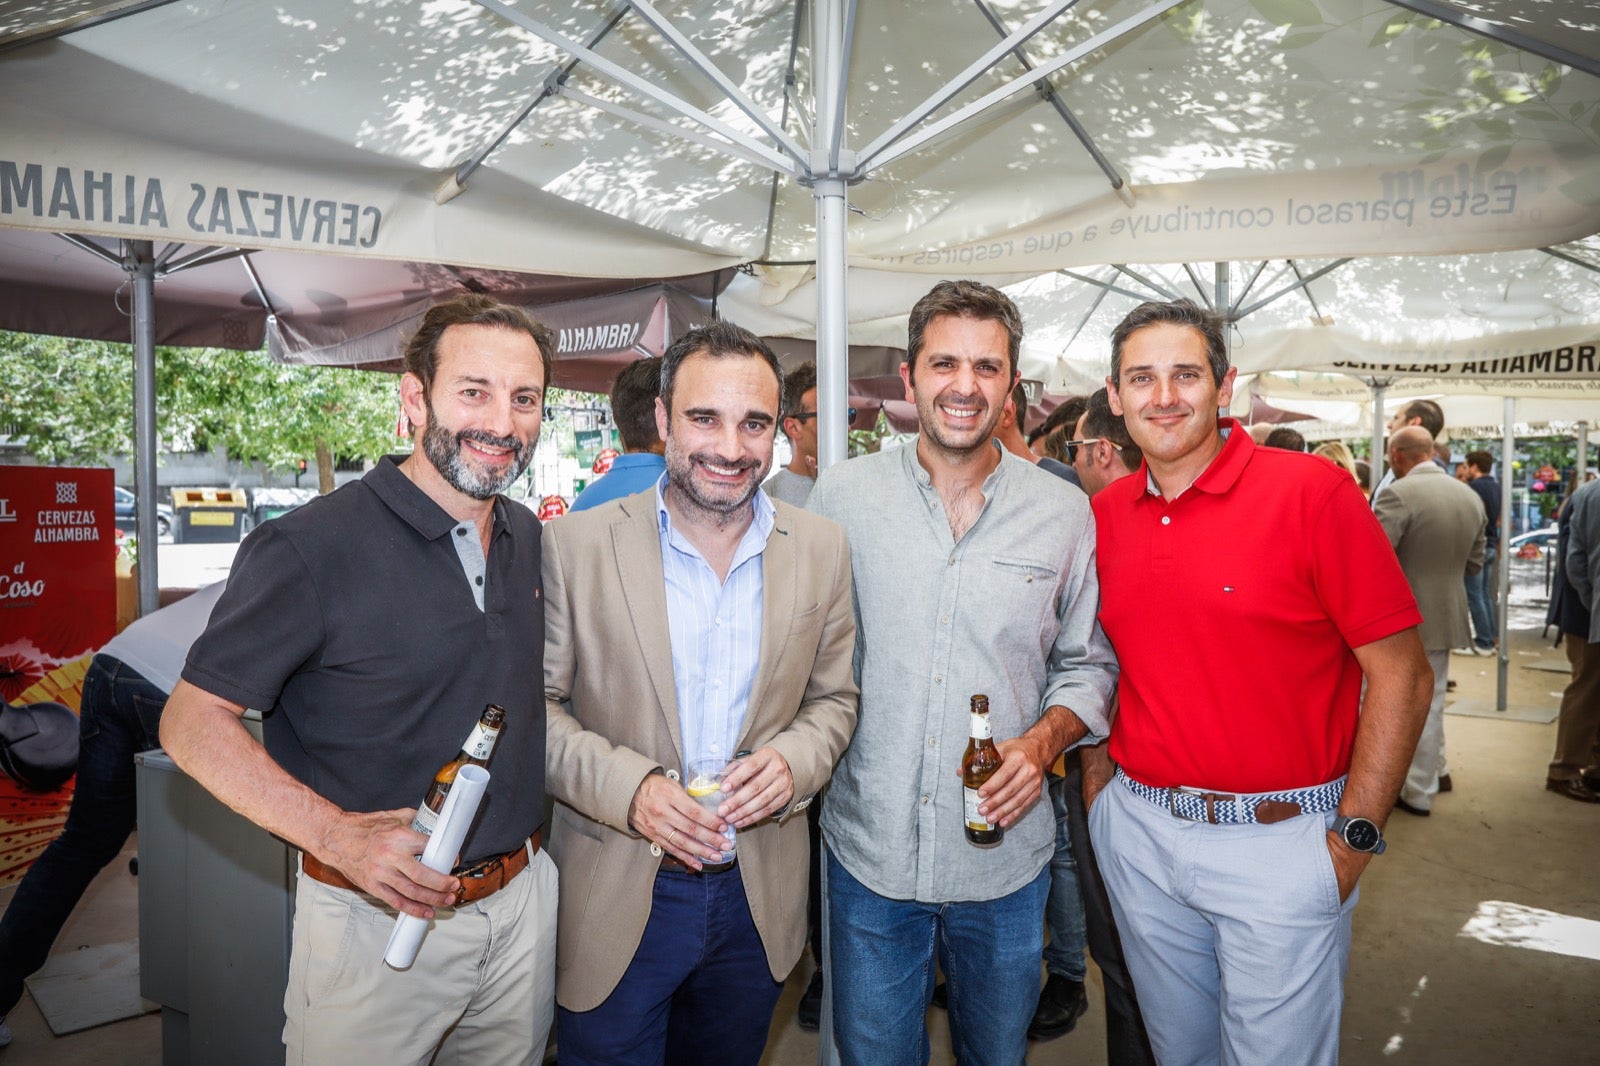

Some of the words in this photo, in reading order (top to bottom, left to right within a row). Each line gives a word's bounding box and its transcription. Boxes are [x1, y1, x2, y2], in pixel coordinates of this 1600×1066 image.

[557, 322, 639, 353] ALHAMBRA
[38, 510, 96, 525] CERVEZAS
[34, 527, 100, 543] ALHAMBRA
[13, 561, 25, 574] el
